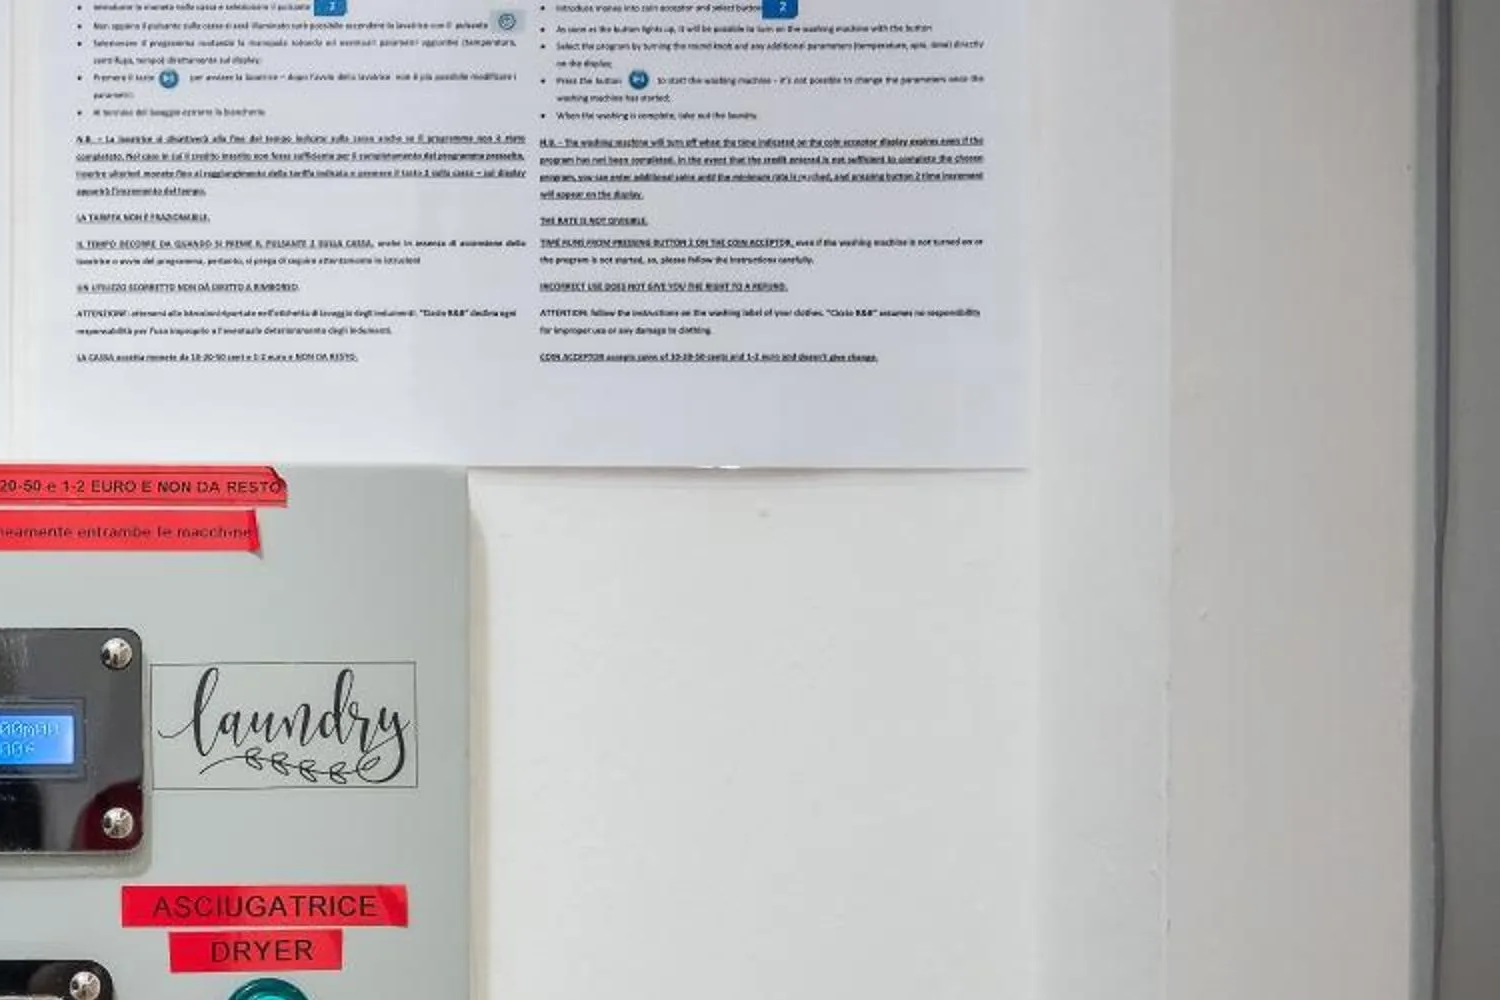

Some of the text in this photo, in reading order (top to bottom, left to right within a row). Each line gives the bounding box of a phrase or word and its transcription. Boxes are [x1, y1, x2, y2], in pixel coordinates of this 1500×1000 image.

[779, 1, 788, 13] 2
[47, 483, 56, 493] e
[63, 480, 85, 493] 1-2
[91, 481, 137, 493] EURO
[142, 481, 152, 493] E
[157, 481, 191, 493] NON
[197, 481, 220, 493] DA
[227, 481, 281, 494] RESTO
[77, 526, 151, 538] entrambe
[157, 526, 172, 538] le
[177, 526, 252, 539] macchine
[158, 667, 410, 783] laundry
[152, 894, 379, 918] ASCIUGATRICE
[210, 938, 315, 963] DRYER
